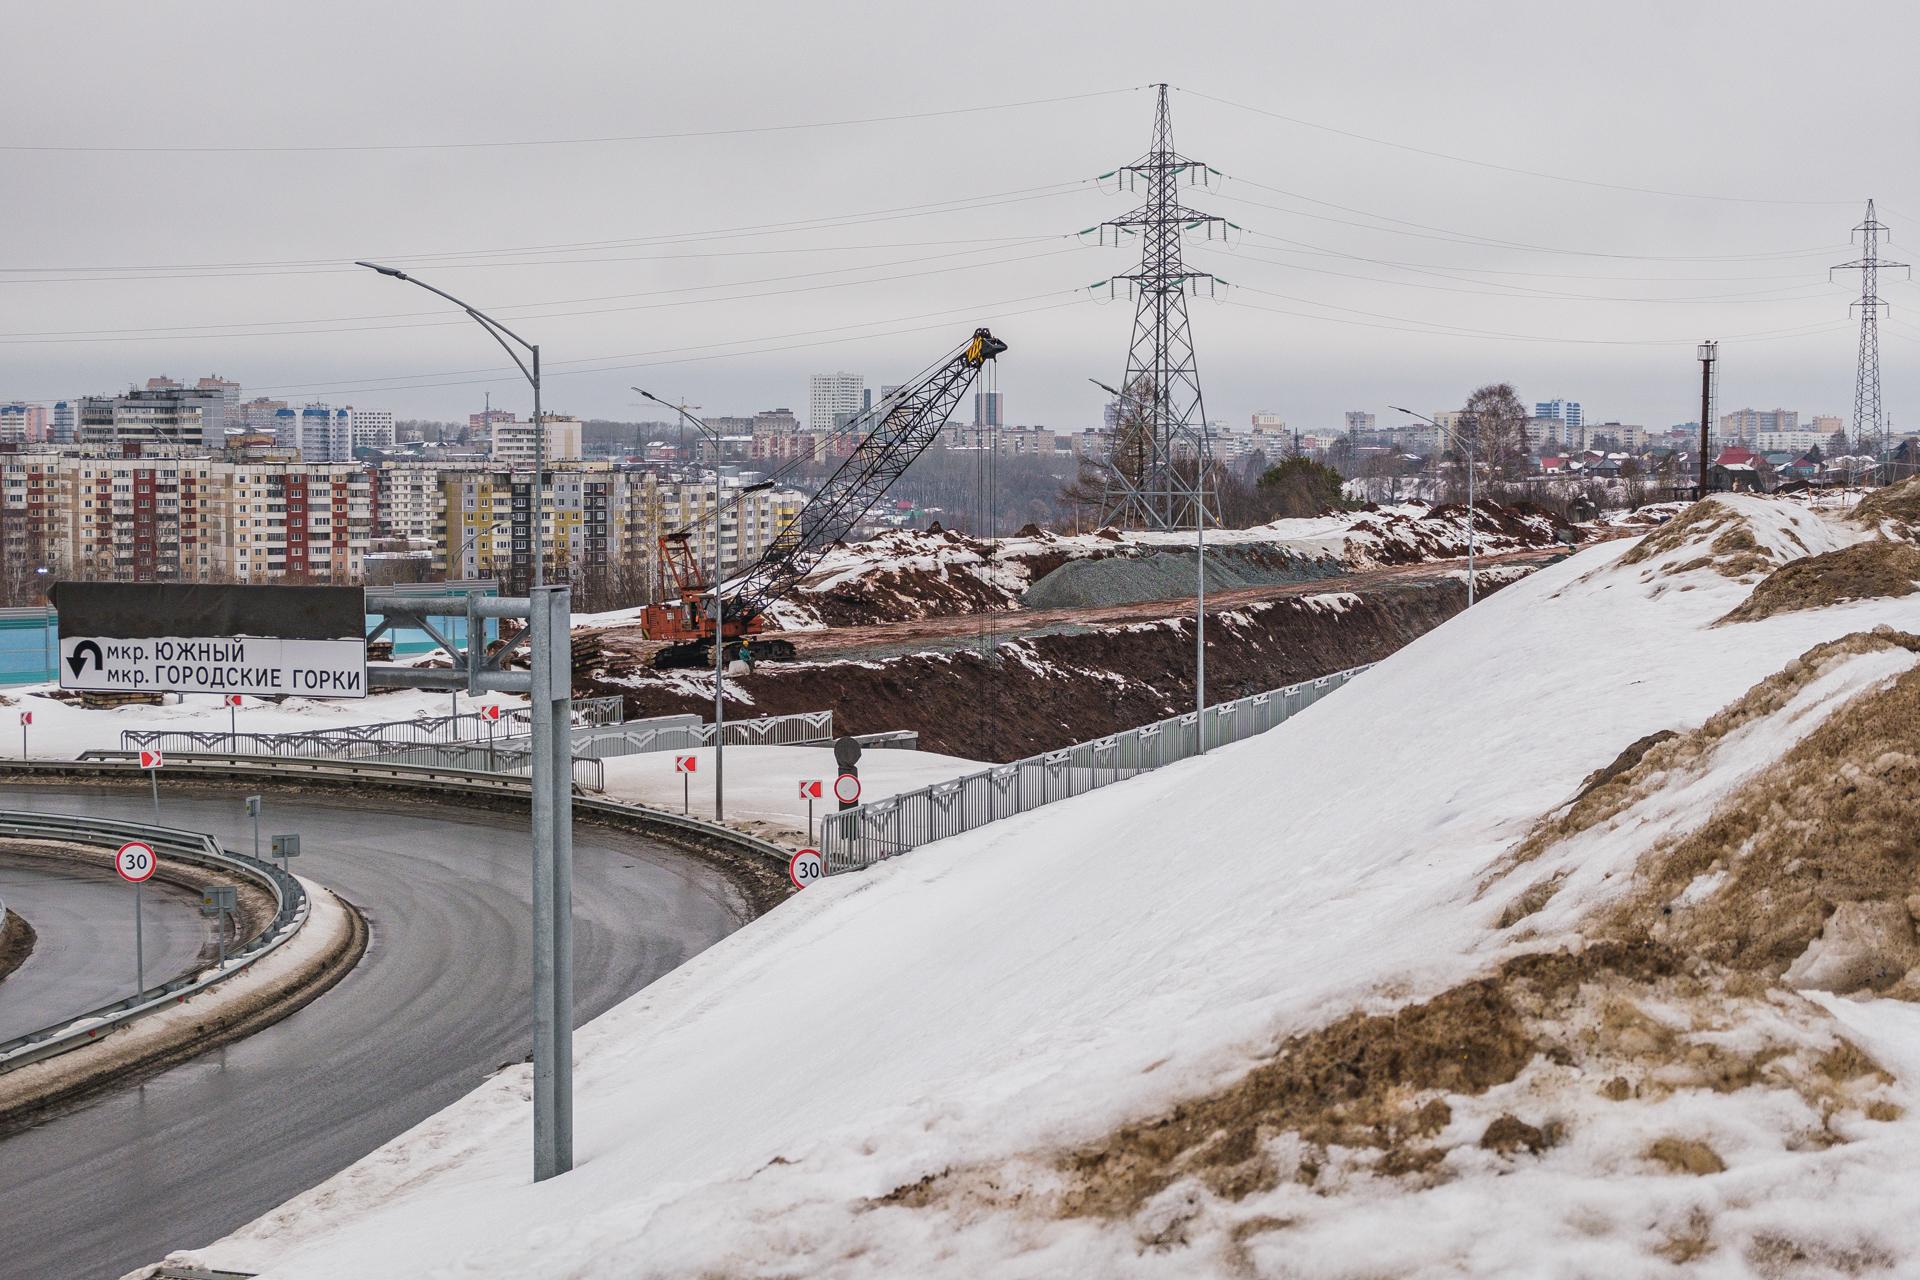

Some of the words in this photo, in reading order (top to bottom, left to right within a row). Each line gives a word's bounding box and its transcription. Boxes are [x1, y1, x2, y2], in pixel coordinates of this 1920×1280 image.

[107, 646, 149, 665] мкр.
[155, 638, 244, 663] ЮЖНЫЙ
[107, 669, 149, 688] мкр.
[155, 665, 282, 689] ГОРОДСКИЕ
[293, 669, 360, 690] ГОРКИ
[125, 854, 147, 870] 30
[799, 862, 819, 878] 30
